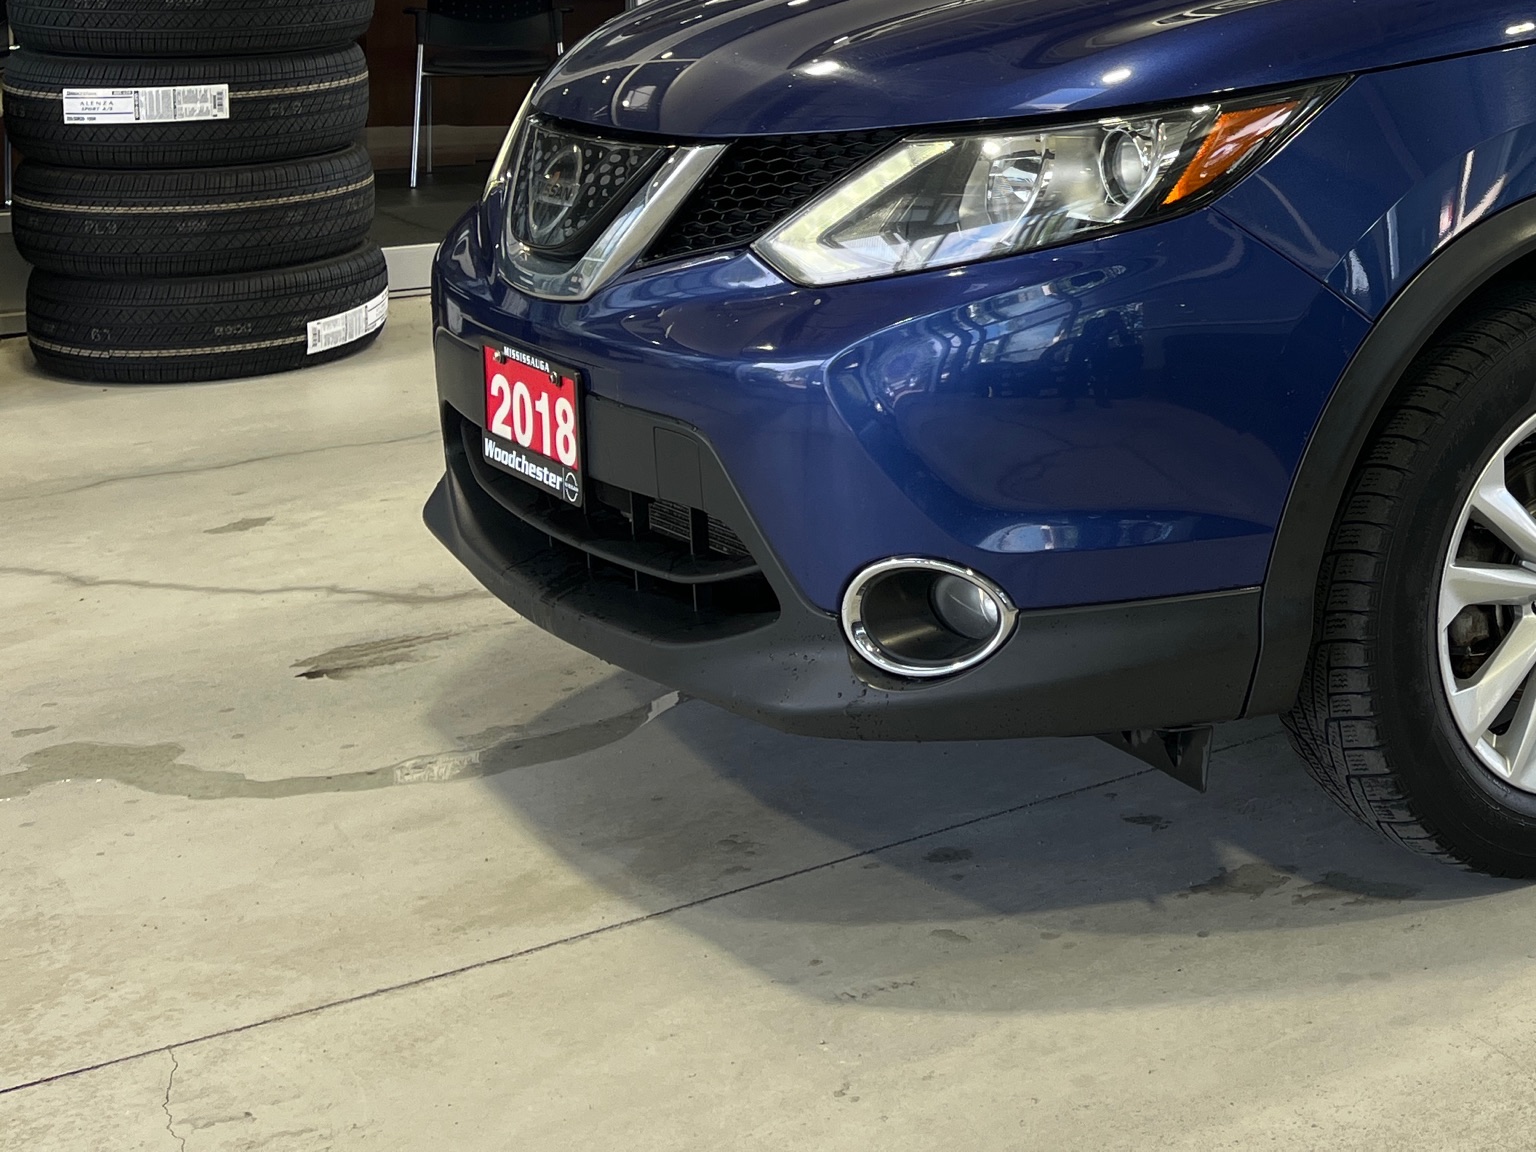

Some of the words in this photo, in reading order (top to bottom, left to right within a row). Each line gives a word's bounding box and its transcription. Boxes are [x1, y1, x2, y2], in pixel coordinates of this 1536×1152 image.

[503, 346, 550, 373] MISSISSAUGA
[490, 373, 577, 467] 2018
[484, 438, 563, 491] Woodchester
